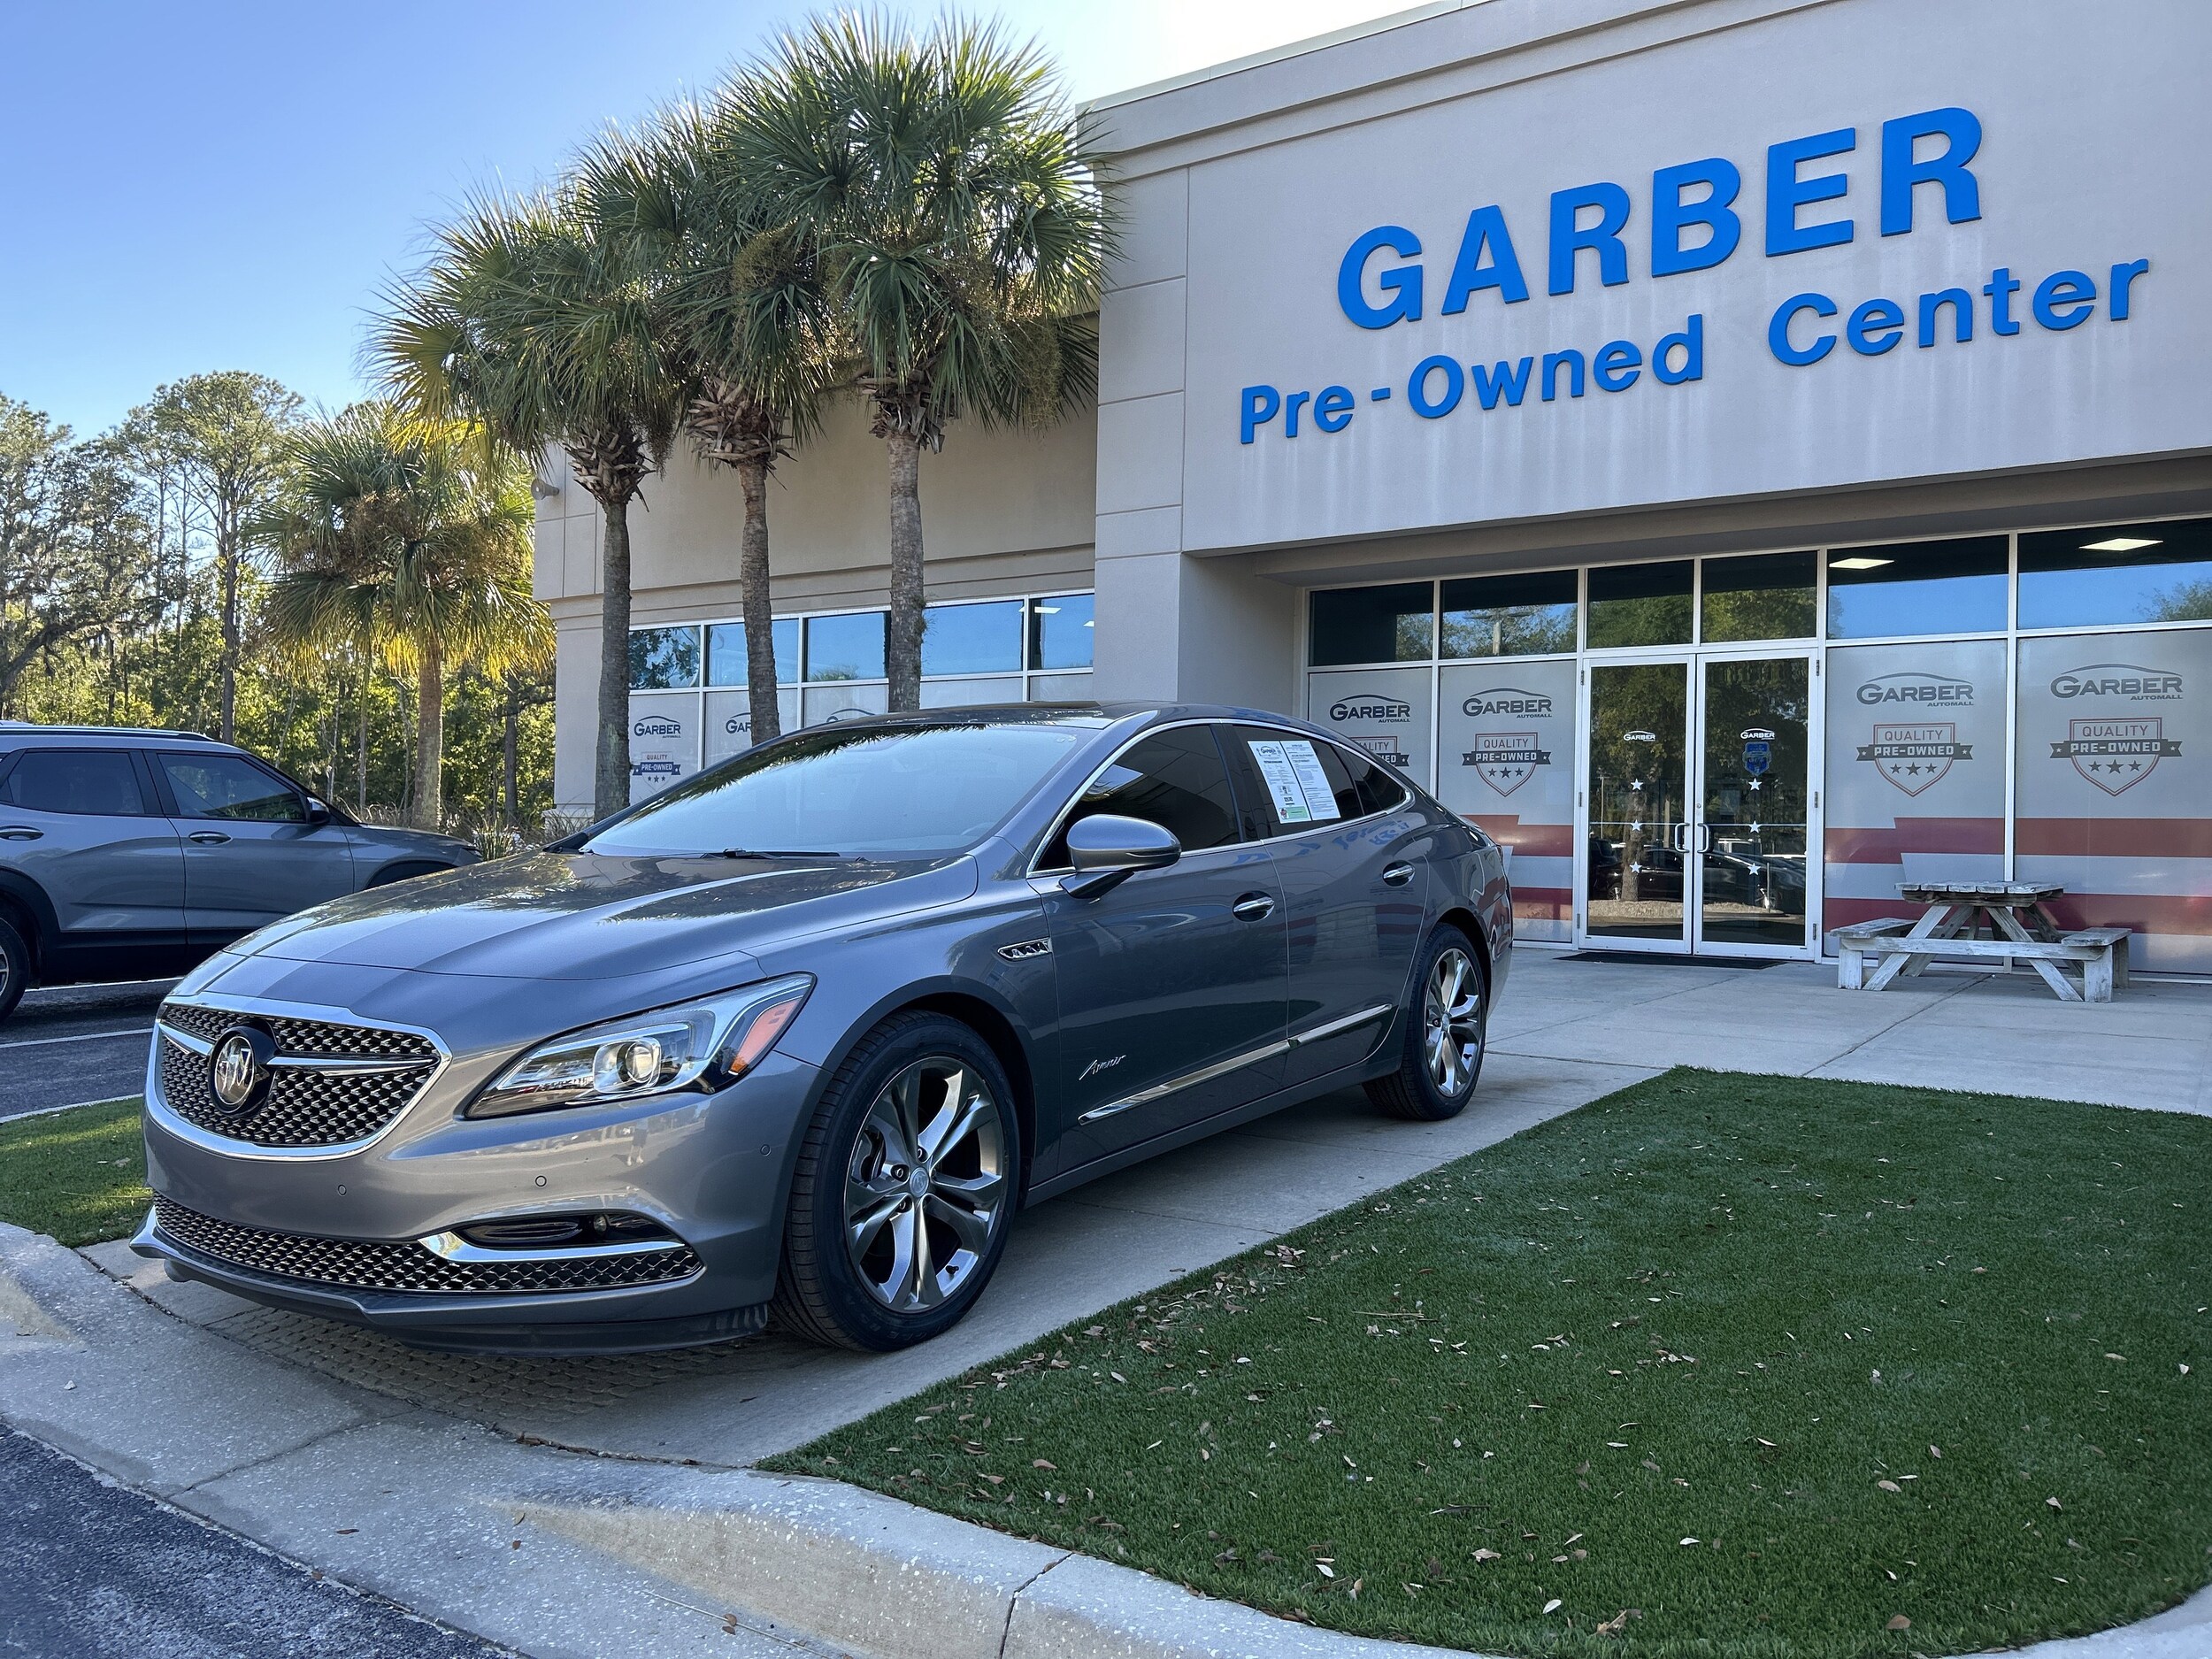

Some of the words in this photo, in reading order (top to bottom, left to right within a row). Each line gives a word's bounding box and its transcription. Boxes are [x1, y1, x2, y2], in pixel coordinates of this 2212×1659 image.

[1337, 107, 1983, 330] GARBER
[1240, 313, 1703, 444] Pre-Owned
[1768, 258, 2149, 365] Center
[2050, 675, 2184, 698] GARBER
[1856, 683, 1974, 705] GARBER
[1329, 703, 1411, 721] GARBER
[1462, 697, 1553, 717] GARBER
[634, 722, 681, 736] GARBER
[1884, 730, 1943, 741] QUALITY
[2082, 725, 2148, 738] QUALITY
[1483, 738, 1529, 749] QUALITY
[2070, 741, 2161, 753] PRE-OWNED
[1475, 752, 1537, 762] PRE-OWNED
[1874, 745, 1954, 757] PRE-OWNED
